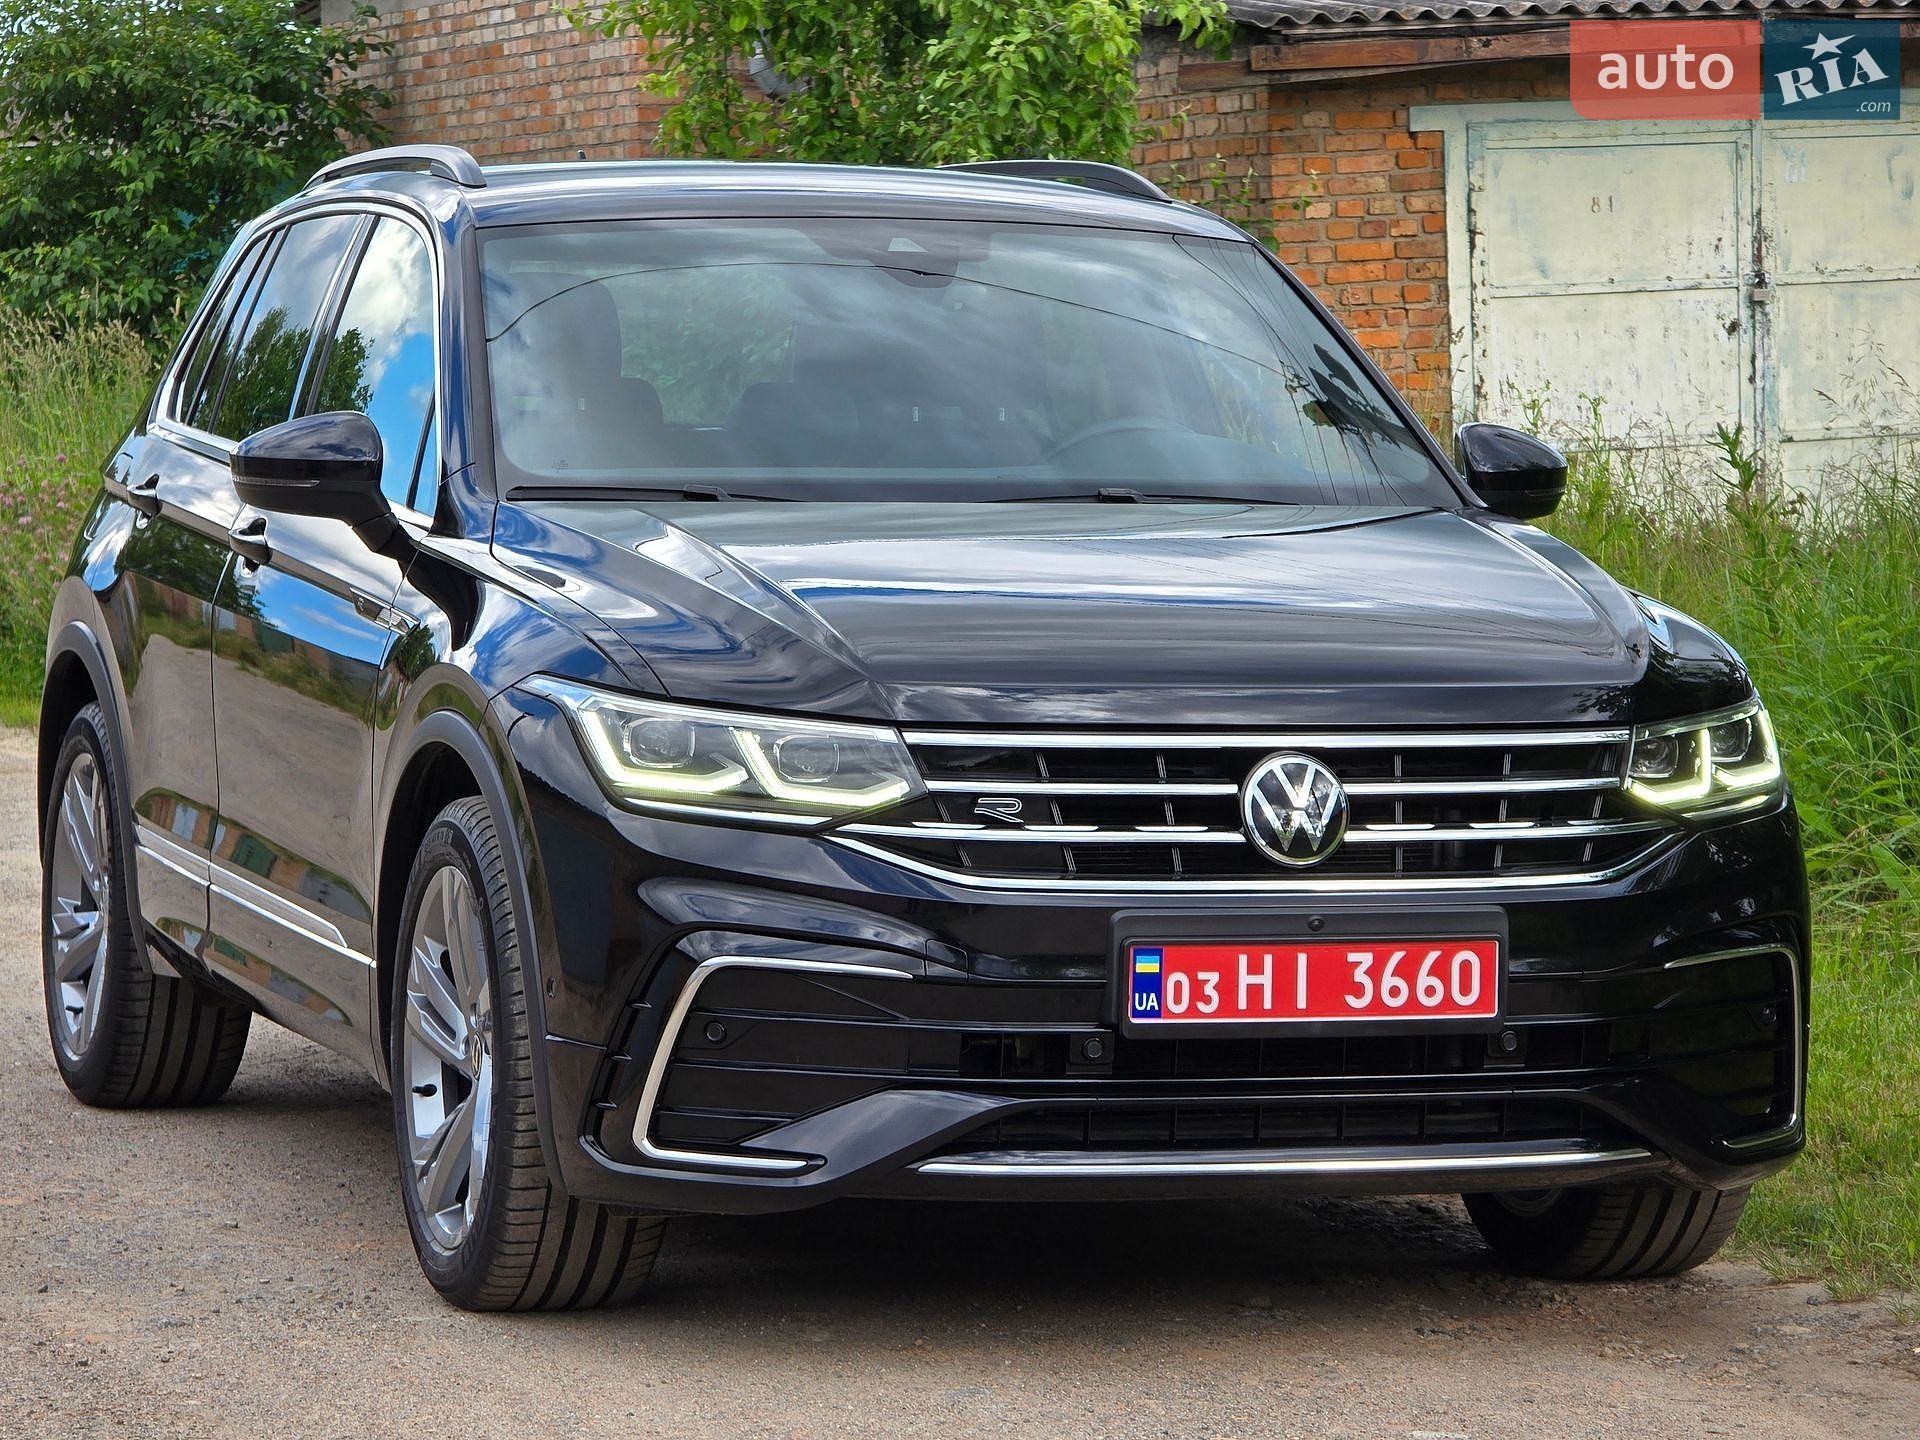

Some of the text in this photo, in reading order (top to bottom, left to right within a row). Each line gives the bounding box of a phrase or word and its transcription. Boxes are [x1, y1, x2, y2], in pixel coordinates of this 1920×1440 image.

[1134, 993, 1159, 1011] UA
[1166, 971, 1220, 1014] 03
[1344, 950, 1481, 1009] 3660
